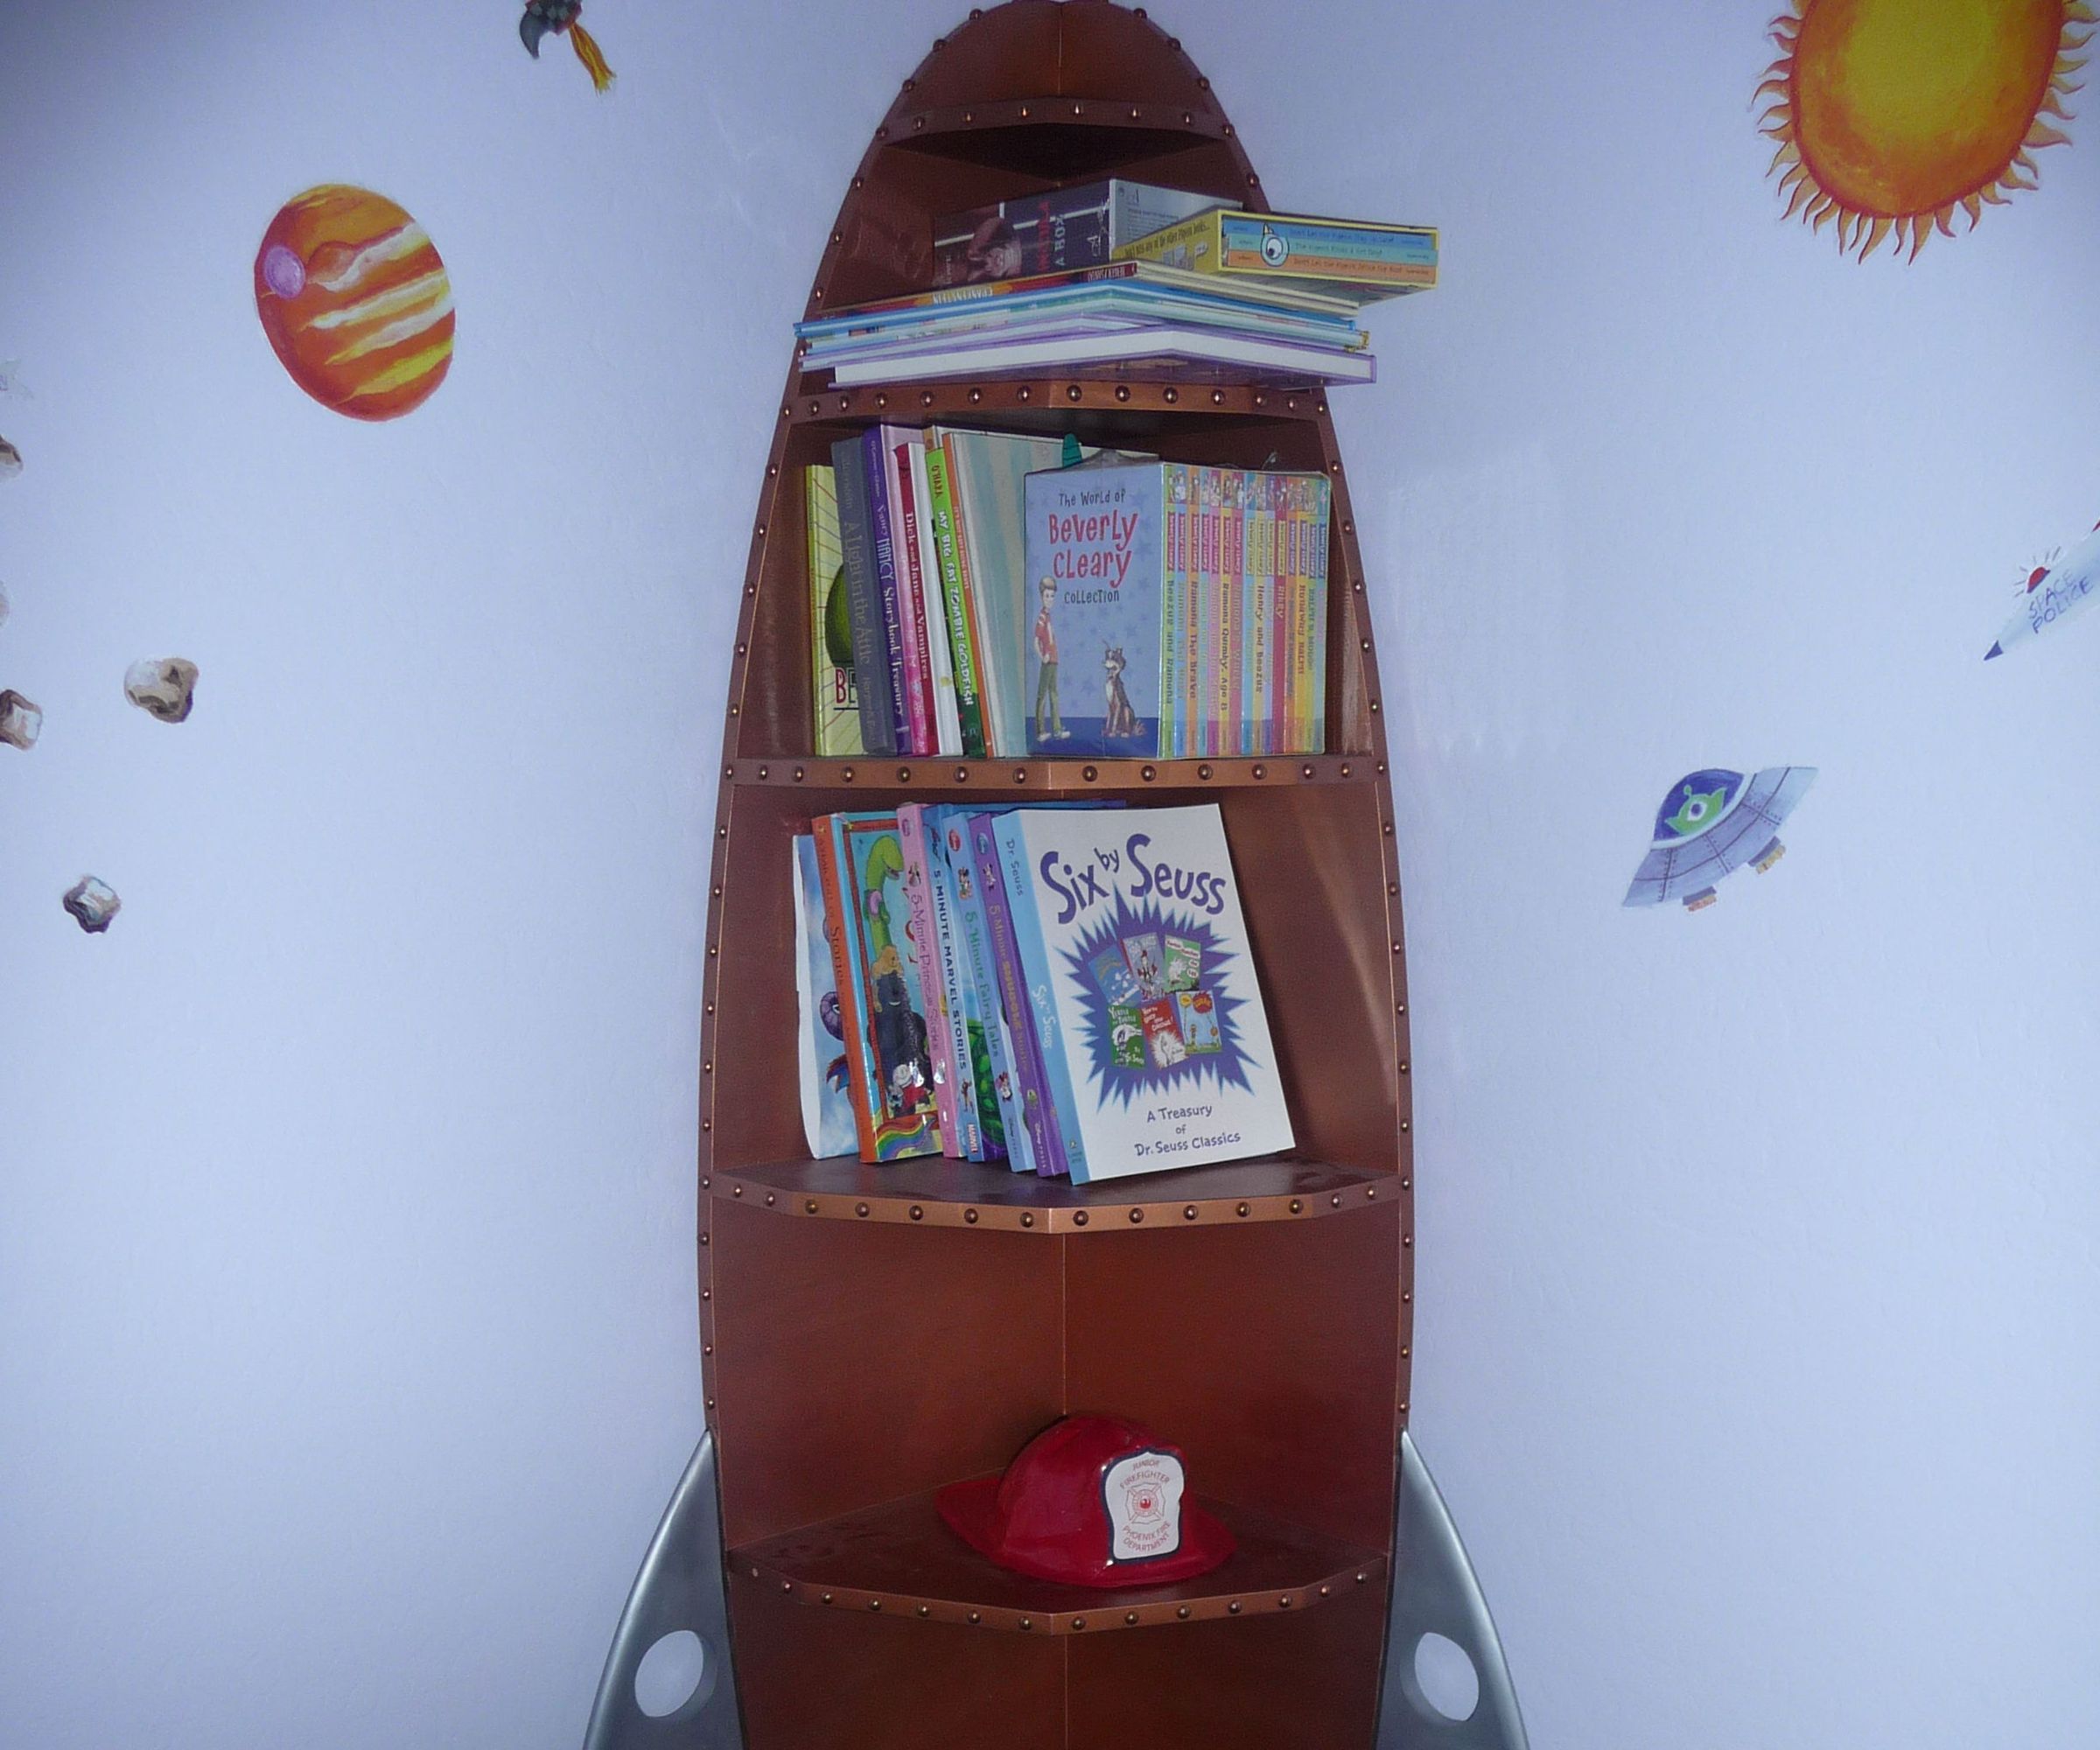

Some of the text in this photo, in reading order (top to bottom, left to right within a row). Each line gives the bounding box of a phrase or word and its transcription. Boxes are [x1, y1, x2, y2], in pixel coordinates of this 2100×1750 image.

[1059, 488, 1126, 508] The World of
[1049, 509, 1138, 551] Beverly
[1054, 550, 1132, 589] Cleary
[906, 511, 914, 543] Dick
[918, 616, 928, 680] Vampires
[949, 586, 966, 640] ZOMBIE
[1254, 585, 1264, 621] Henry
[2029, 569, 2074, 620] SPACE
[2032, 576, 2094, 634] POLICE
[957, 643, 975, 706] GOLDFISH
[1012, 861, 1024, 898] Seuss
[1040, 833, 1227, 925] Six by Seuss
[942, 945, 958, 1006] MARVEL
[951, 1009, 968, 1070] STORIES
[1146, 1105, 1213, 1123] A Treasury
[1175, 1124, 1186, 1135] of
[1134, 1131, 1242, 1157] Dr. Seuss Classics
[1119, 1470, 1170, 1489] FIREFIGHTER
[1132, 1460, 1161, 1471] JUNIOR
[1123, 1525, 1156, 1541] PHOENIX
[1123, 1533, 1170, 1551] DEPARTMENT
